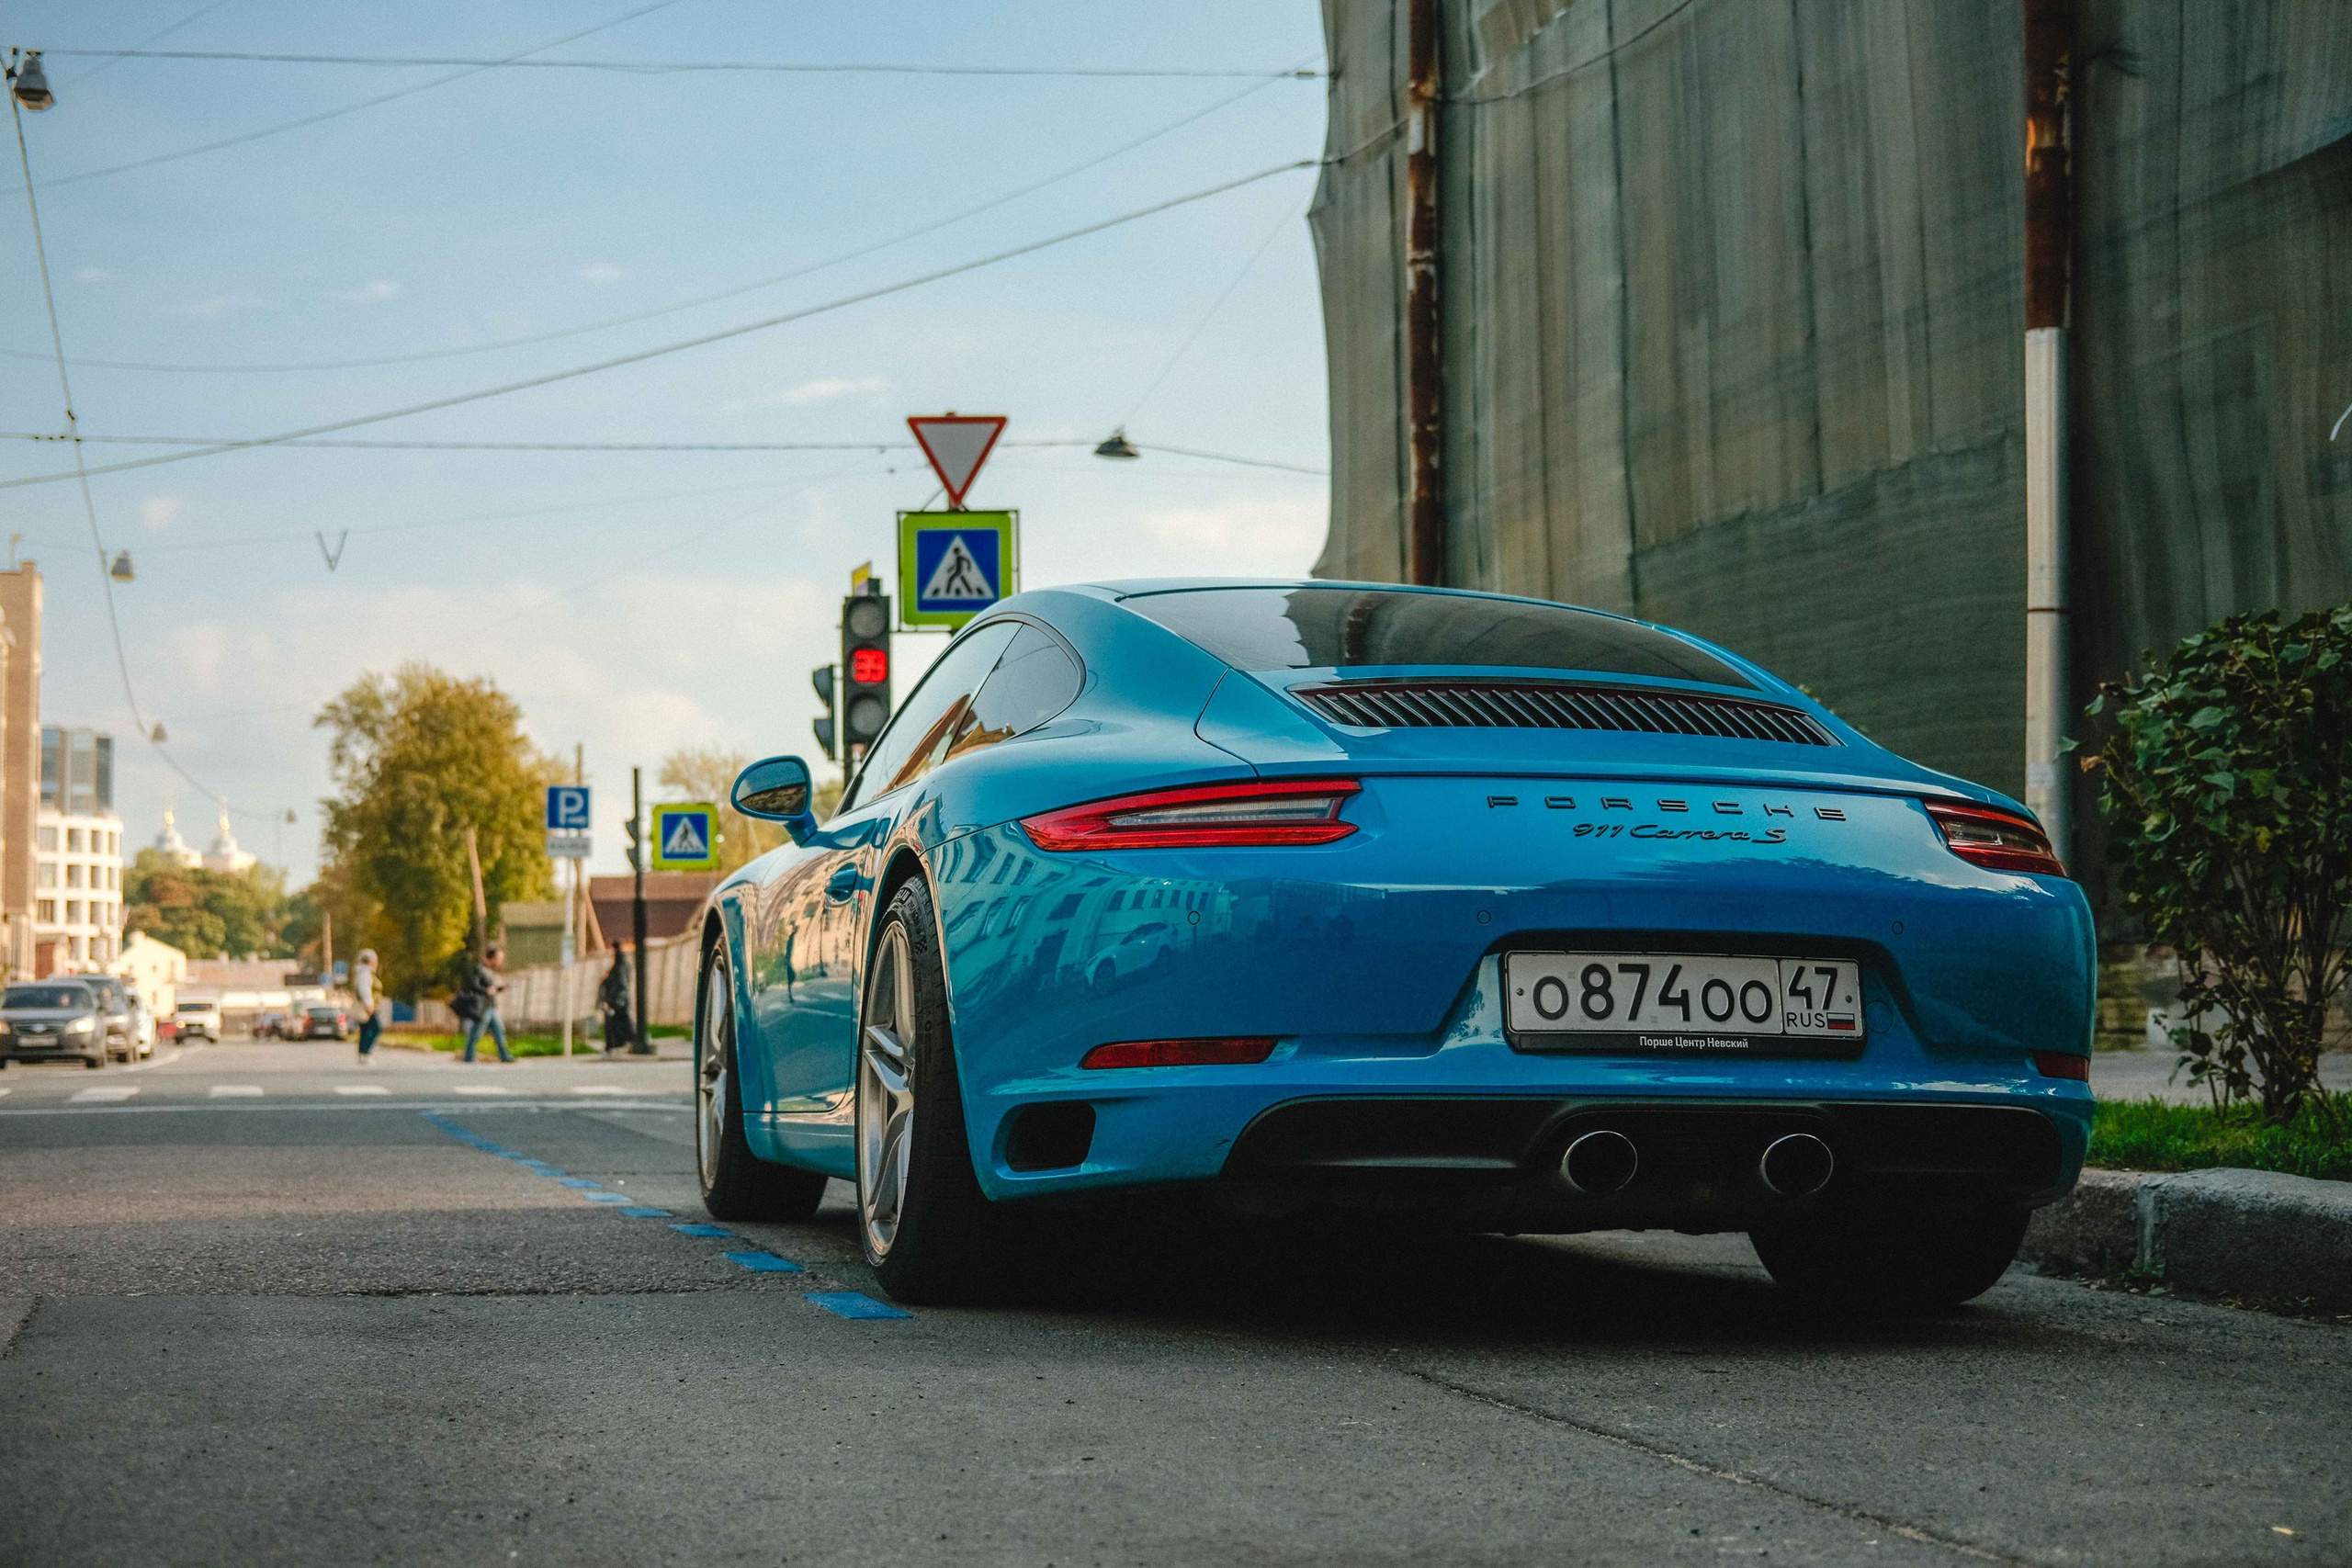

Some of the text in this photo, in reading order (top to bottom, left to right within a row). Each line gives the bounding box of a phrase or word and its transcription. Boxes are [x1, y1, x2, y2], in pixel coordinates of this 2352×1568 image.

[559, 790, 584, 825] P
[1486, 795, 1847, 821] PORSCHE
[1573, 823, 1787, 843] 911 Carrera S
[1787, 965, 1838, 1010] 47
[1786, 1011, 1826, 1029] RUS
[1639, 1036, 1749, 1050] Порше Центр Невский
